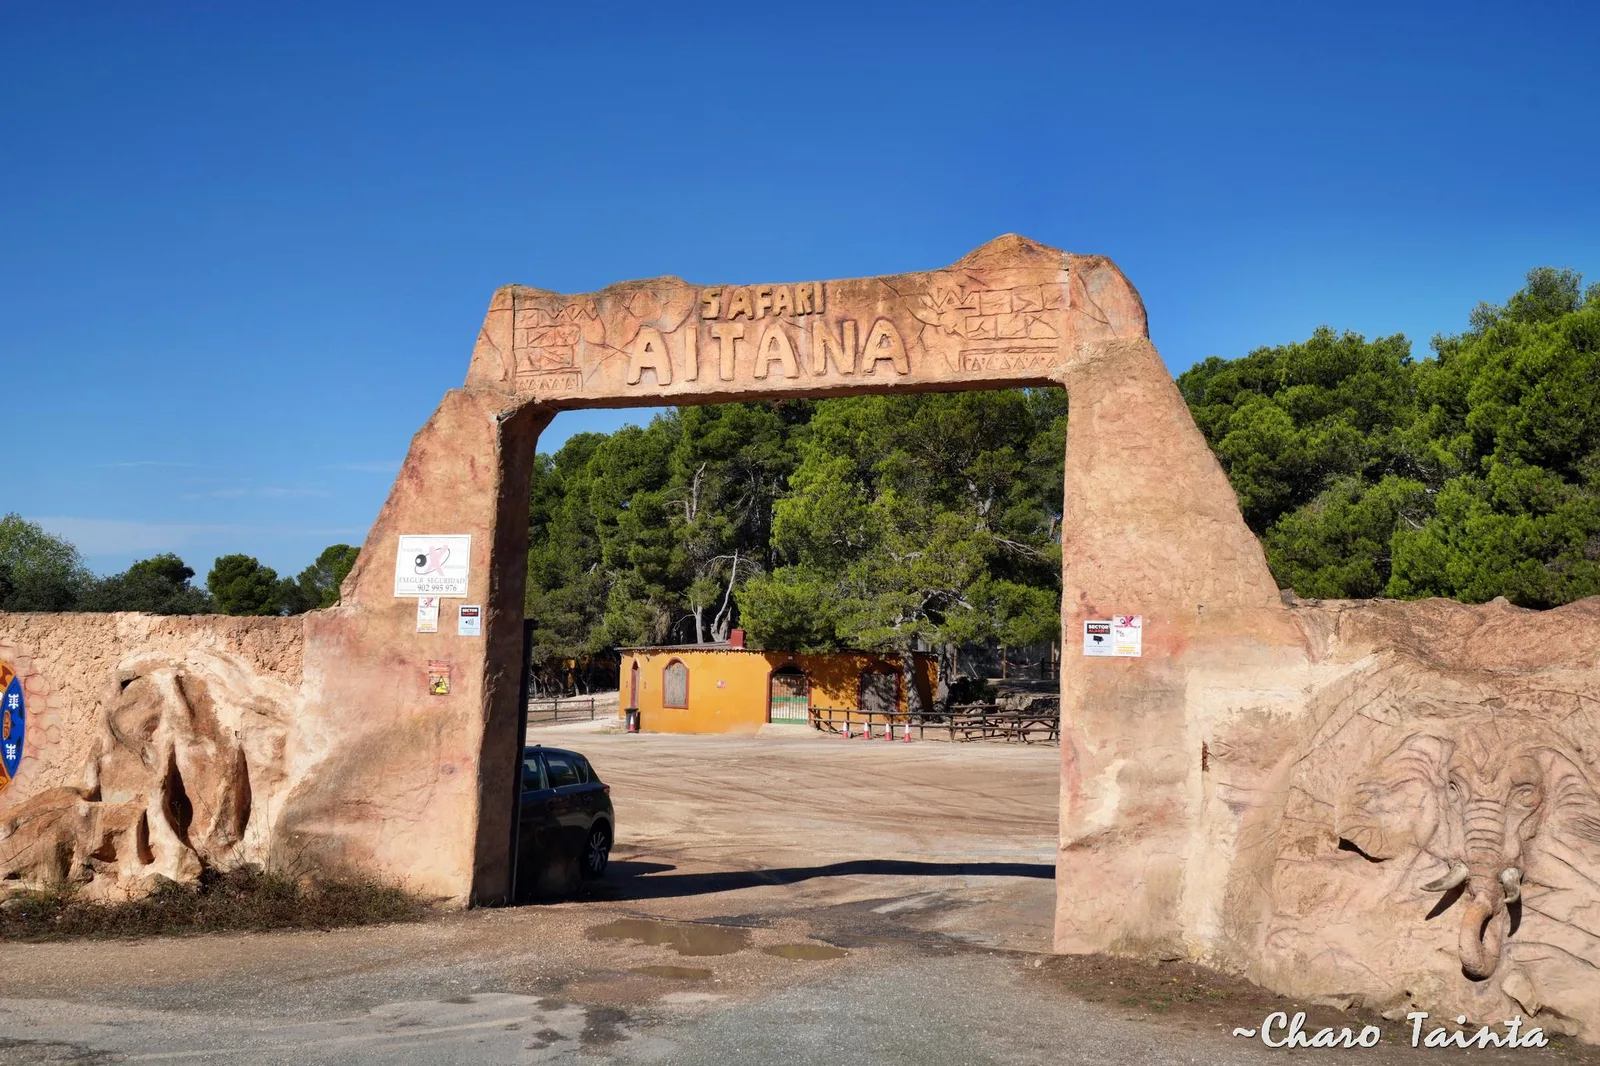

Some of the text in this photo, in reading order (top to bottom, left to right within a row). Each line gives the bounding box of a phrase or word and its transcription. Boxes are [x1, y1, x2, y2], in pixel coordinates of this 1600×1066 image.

[702, 282, 826, 320] SAFARI
[627, 317, 910, 386] AITANA
[417, 584, 430, 592] 902
